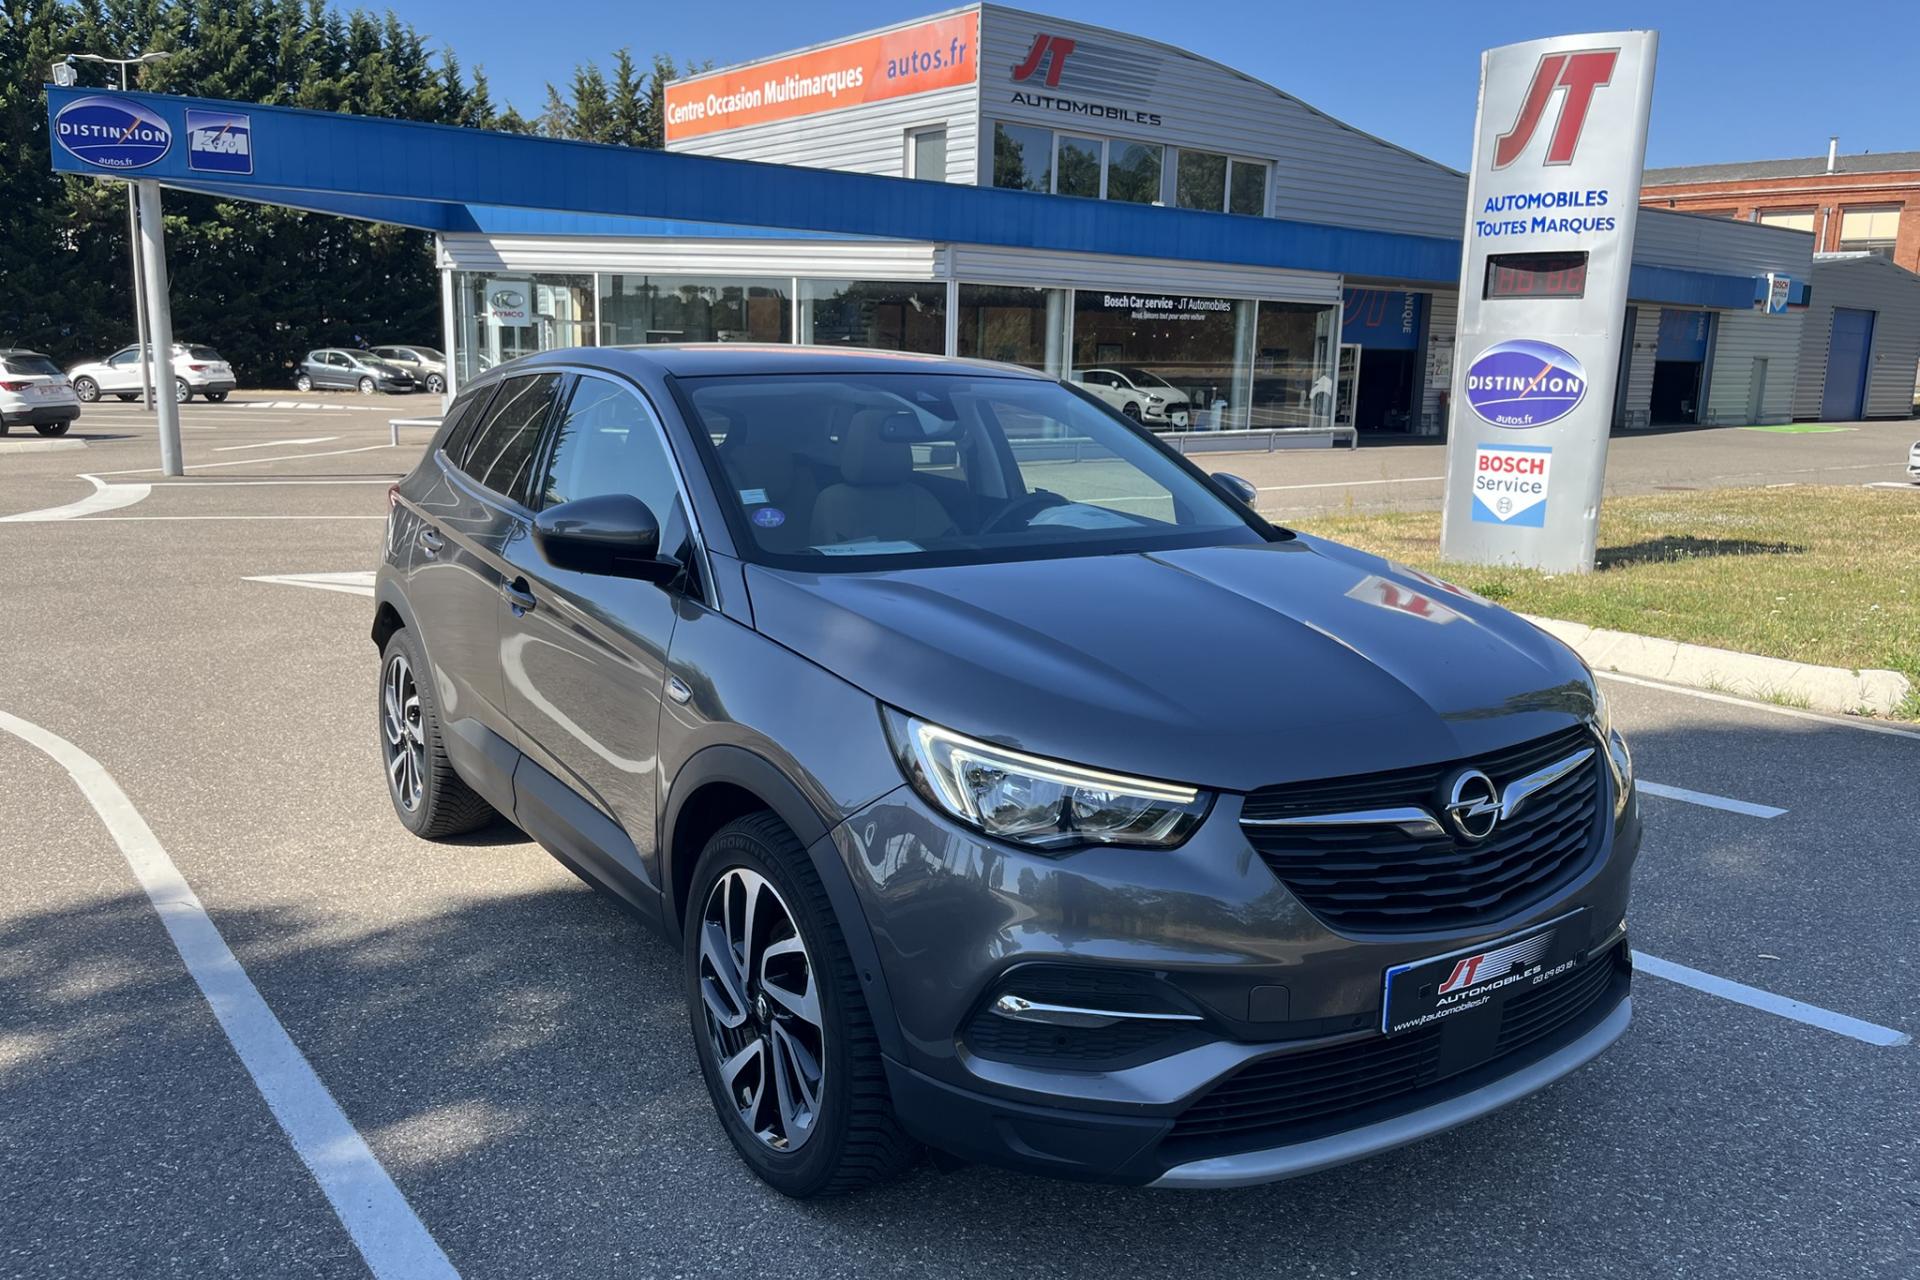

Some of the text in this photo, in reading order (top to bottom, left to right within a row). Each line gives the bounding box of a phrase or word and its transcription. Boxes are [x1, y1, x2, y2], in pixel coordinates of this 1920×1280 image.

[1012, 32, 1076, 89] JT
[667, 37, 967, 125] Centre Occasion Multimarques autos.fr
[1011, 92, 1161, 126] AUTOMOBILES
[1491, 46, 1621, 171] JT
[60, 122, 166, 143] DISTINXION
[98, 156, 133, 167] autos.fr
[1484, 190, 1609, 213] AUTOMOBILES
[1104, 295, 1129, 307] Bosch
[1130, 296, 1144, 308] Car
[1145, 297, 1173, 309] service
[1178, 298, 1187, 309] JT
[1188, 299, 1231, 311] Automobiles
[1402, 291, 1414, 334] NIQUE
[1468, 376, 1580, 393] DISTINXION
[1496, 414, 1533, 425] autos.fr
[1478, 455, 1545, 475] BOSCH
[1476, 475, 1542, 494] Service
[1436, 964, 1542, 1007] AUTOMOBILES
[1437, 954, 1486, 995] JT
[1393, 994, 1491, 1032] www.jtautomobiles.fr
